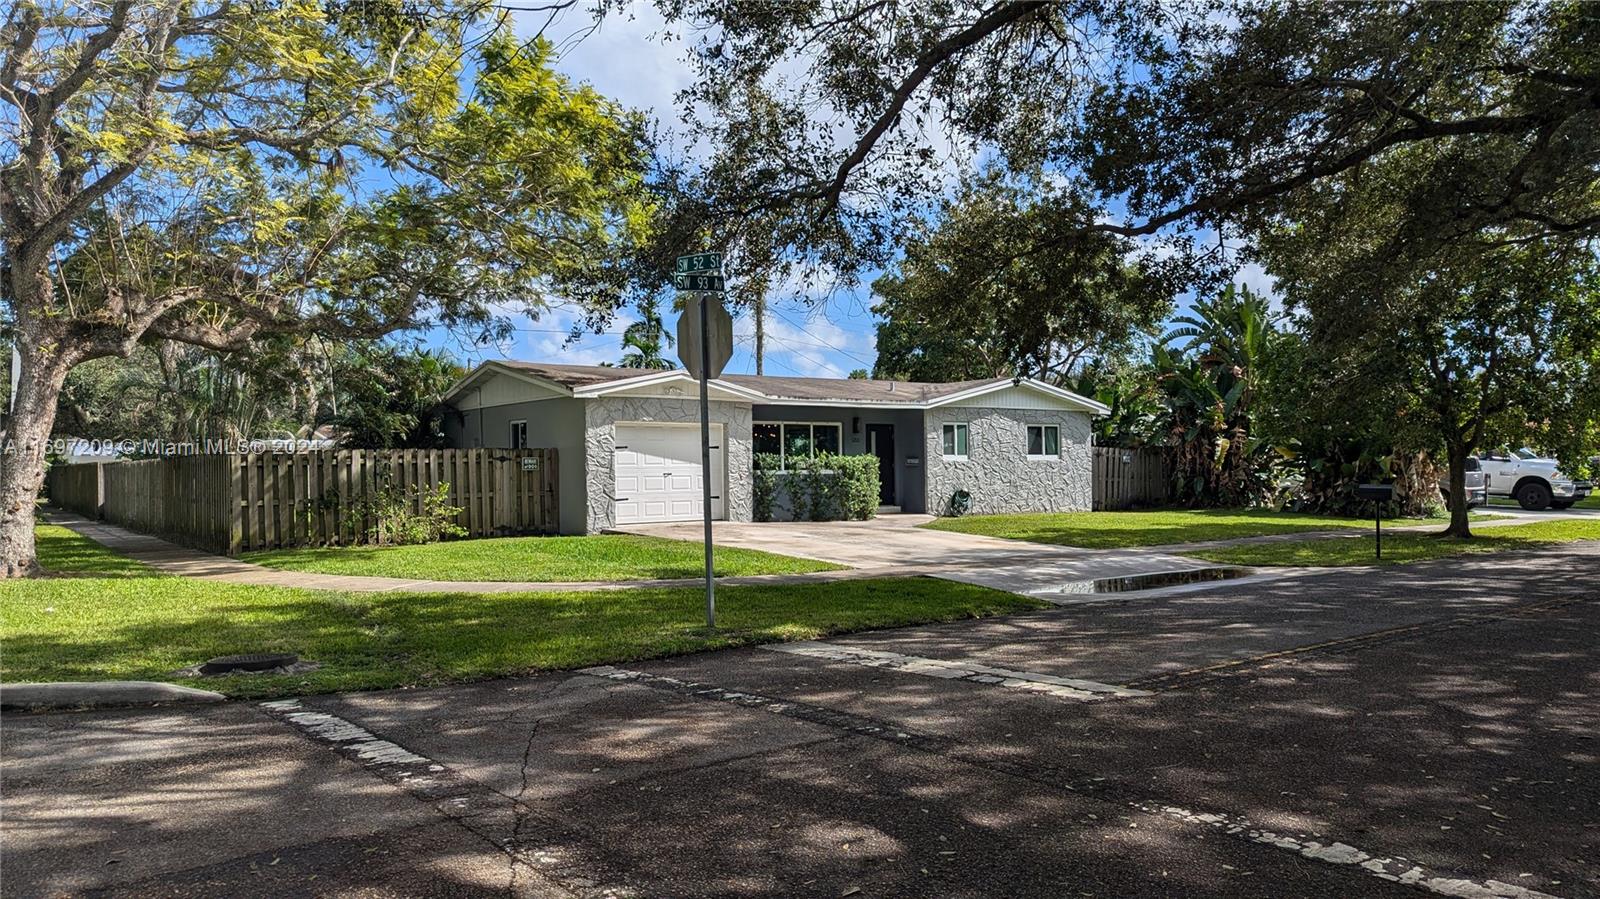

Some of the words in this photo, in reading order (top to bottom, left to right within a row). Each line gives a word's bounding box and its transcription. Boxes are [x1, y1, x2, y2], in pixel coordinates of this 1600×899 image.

[678, 259, 689, 271] SW
[693, 256, 704, 269] 52
[710, 255, 720, 268] St
[677, 276, 690, 289] SW
[697, 276, 709, 289] 93
